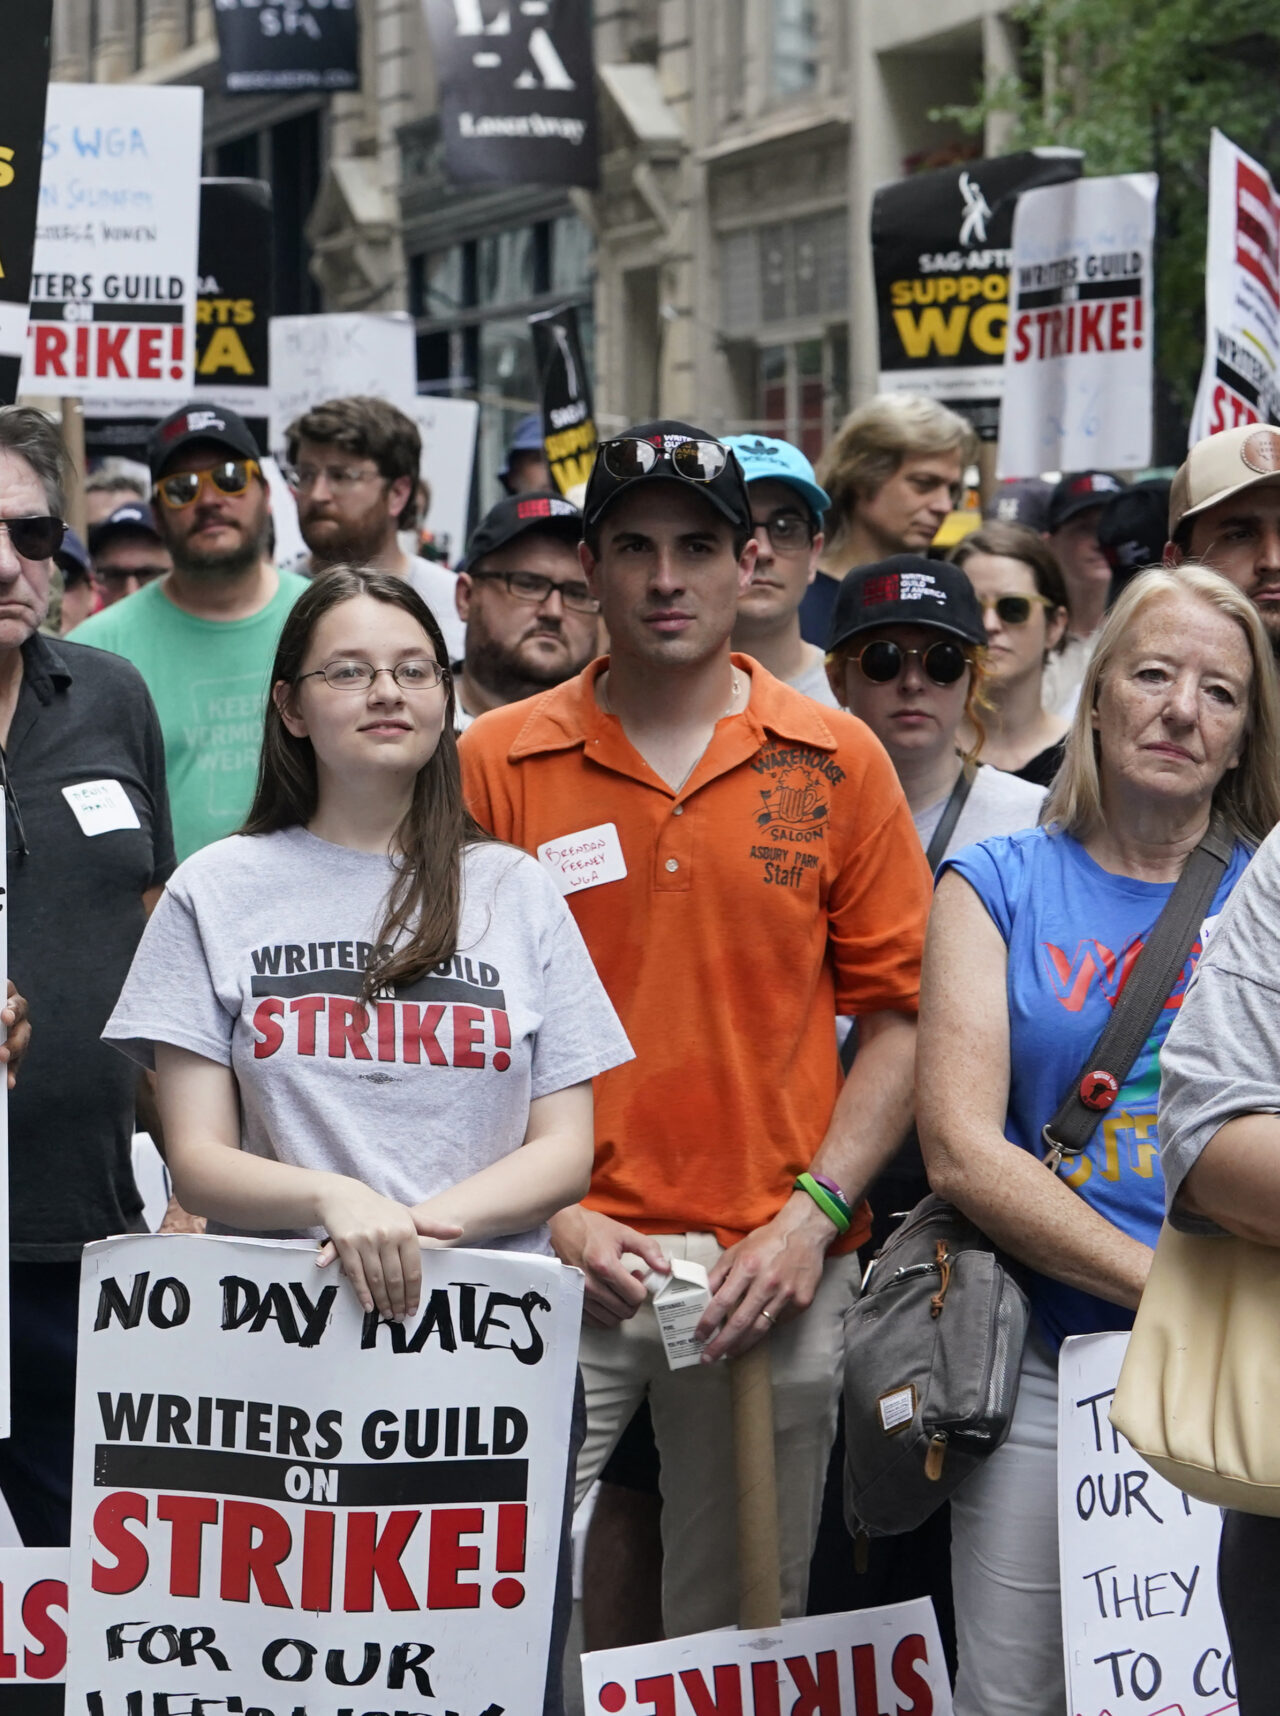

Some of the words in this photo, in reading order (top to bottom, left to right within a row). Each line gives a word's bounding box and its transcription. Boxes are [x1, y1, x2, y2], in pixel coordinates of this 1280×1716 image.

[73, 125, 149, 158] WGA
[1086, 252, 1143, 278] GUILD
[104, 275, 184, 300] GUILD
[890, 273, 1012, 305] SUPPO
[1014, 297, 1143, 363] STRIKE!
[27, 326, 184, 380] RIKE!
[750, 748, 847, 787] WAREHOUSE
[770, 828, 824, 843] SALOON
[561, 852, 605, 873] FEENEY
[750, 845, 789, 863] ASBURY
[794, 851, 819, 869] PARK
[763, 861, 803, 889] Staff
[570, 870, 599, 887] WGA
[253, 996, 511, 1072] STRIKE!
[94, 1271, 191, 1332] NO
[219, 1275, 340, 1348] DAY
[97, 1391, 343, 1461] WRITERS
[361, 1405, 529, 1461] GUILD
[284, 1465, 339, 1503] ON
[1076, 1470, 1163, 1524] OUR
[91, 1490, 528, 1613] STRIKE!
[1082, 1565, 1200, 1621] THEY
[105, 1621, 232, 1672] FOR
[261, 1638, 436, 1698] OUR
[1093, 1648, 1162, 1702] TO
